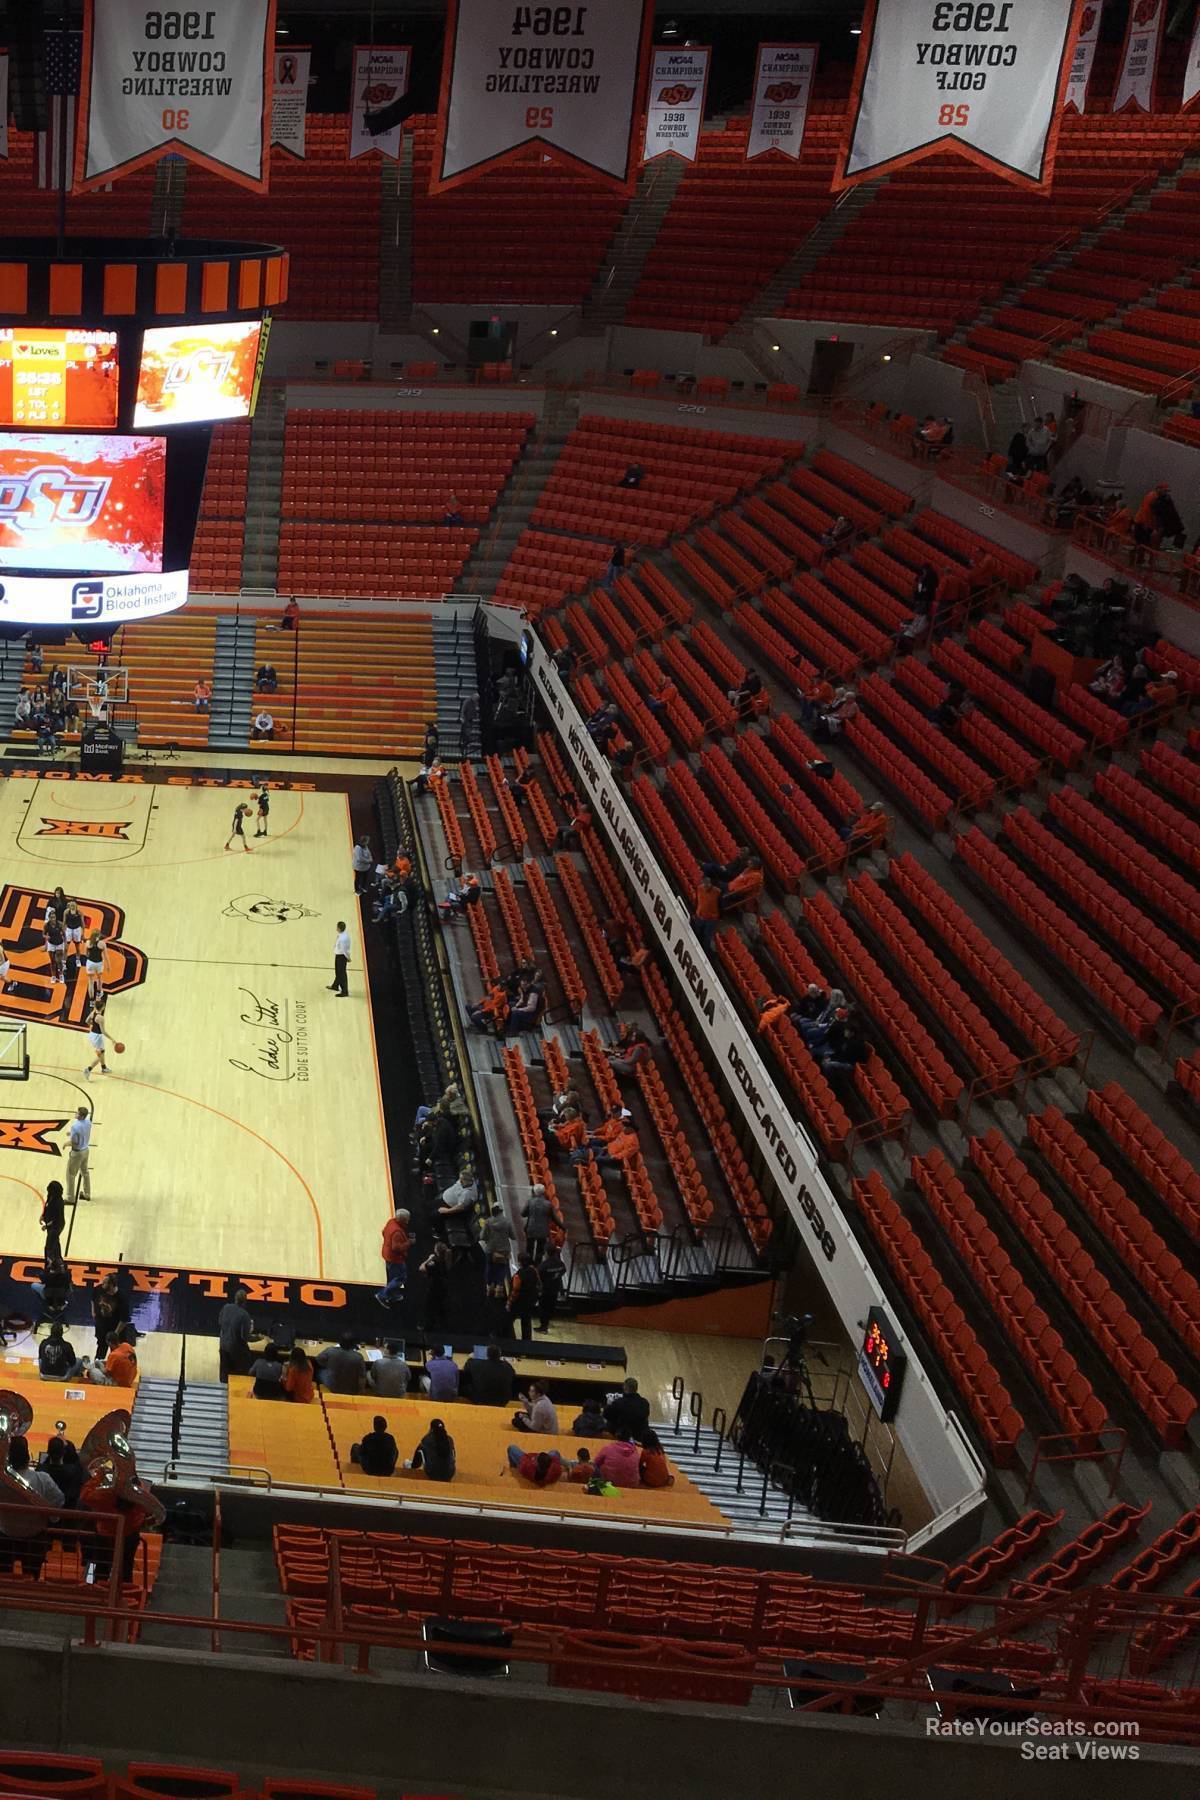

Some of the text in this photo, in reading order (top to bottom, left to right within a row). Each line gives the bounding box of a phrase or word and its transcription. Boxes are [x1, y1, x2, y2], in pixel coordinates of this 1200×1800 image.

[669, 56, 694, 65] NCAA
[655, 66, 704, 76] CHAMPIONS
[762, 64, 810, 73] CHAMPIONS
[663, 112, 686, 122] 1938
[769, 110, 791, 120] 1939
[658, 124, 688, 132] COWBOY
[397, 388, 423, 396] 219
[677, 403, 707, 414] 220
[106, 582, 162, 599] Oklahoma
[106, 590, 178, 611] Blood Institute
[167, 775, 317, 792] STATE
[568, 725, 599, 793] HISTORIC
[601, 788, 673, 941] GALLAGHER-IBA
[674, 938, 716, 1026] ARENA
[728, 1043, 797, 1184] DEDICATED
[797, 1184, 836, 1262] 1938
[295, 1000, 309, 1082] EDDIE SUTTON COURT
